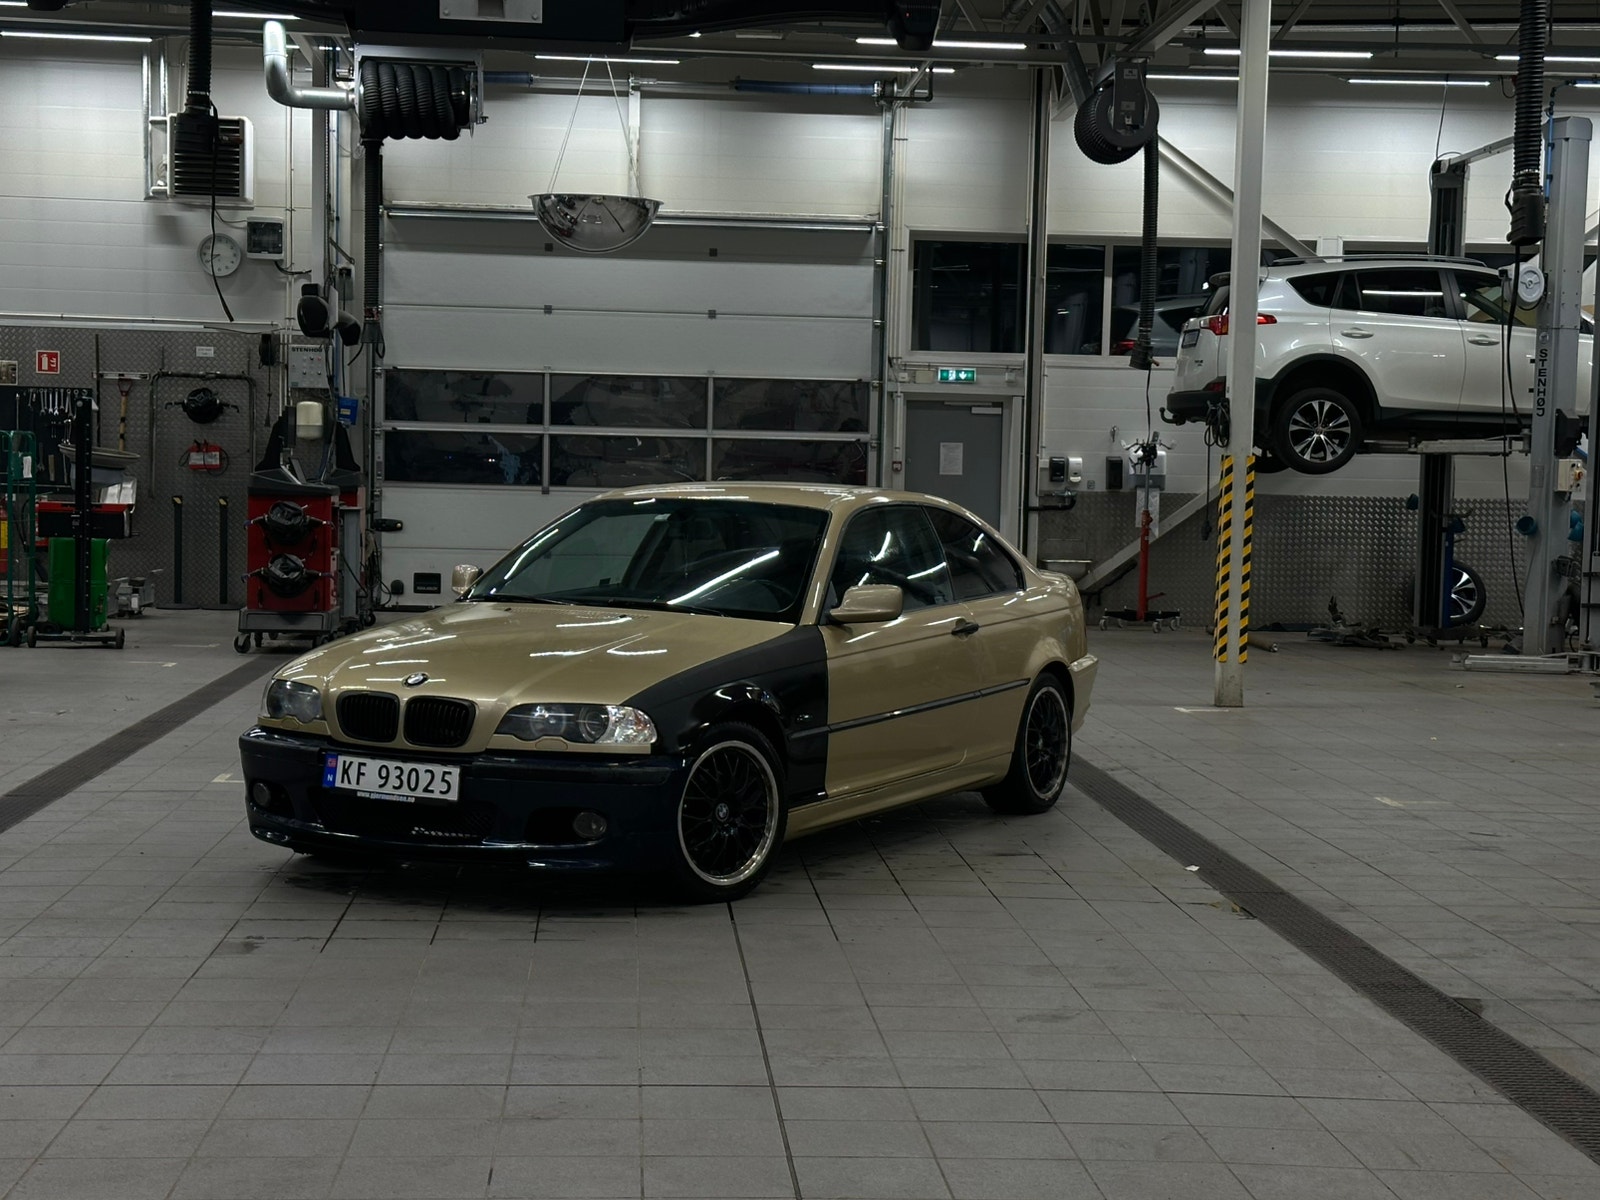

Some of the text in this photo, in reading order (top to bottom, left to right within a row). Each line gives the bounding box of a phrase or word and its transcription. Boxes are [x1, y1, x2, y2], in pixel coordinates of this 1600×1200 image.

[1536, 349, 1548, 417] STENHØJ
[327, 773, 333, 782] N
[340, 760, 453, 795] KF 93025
